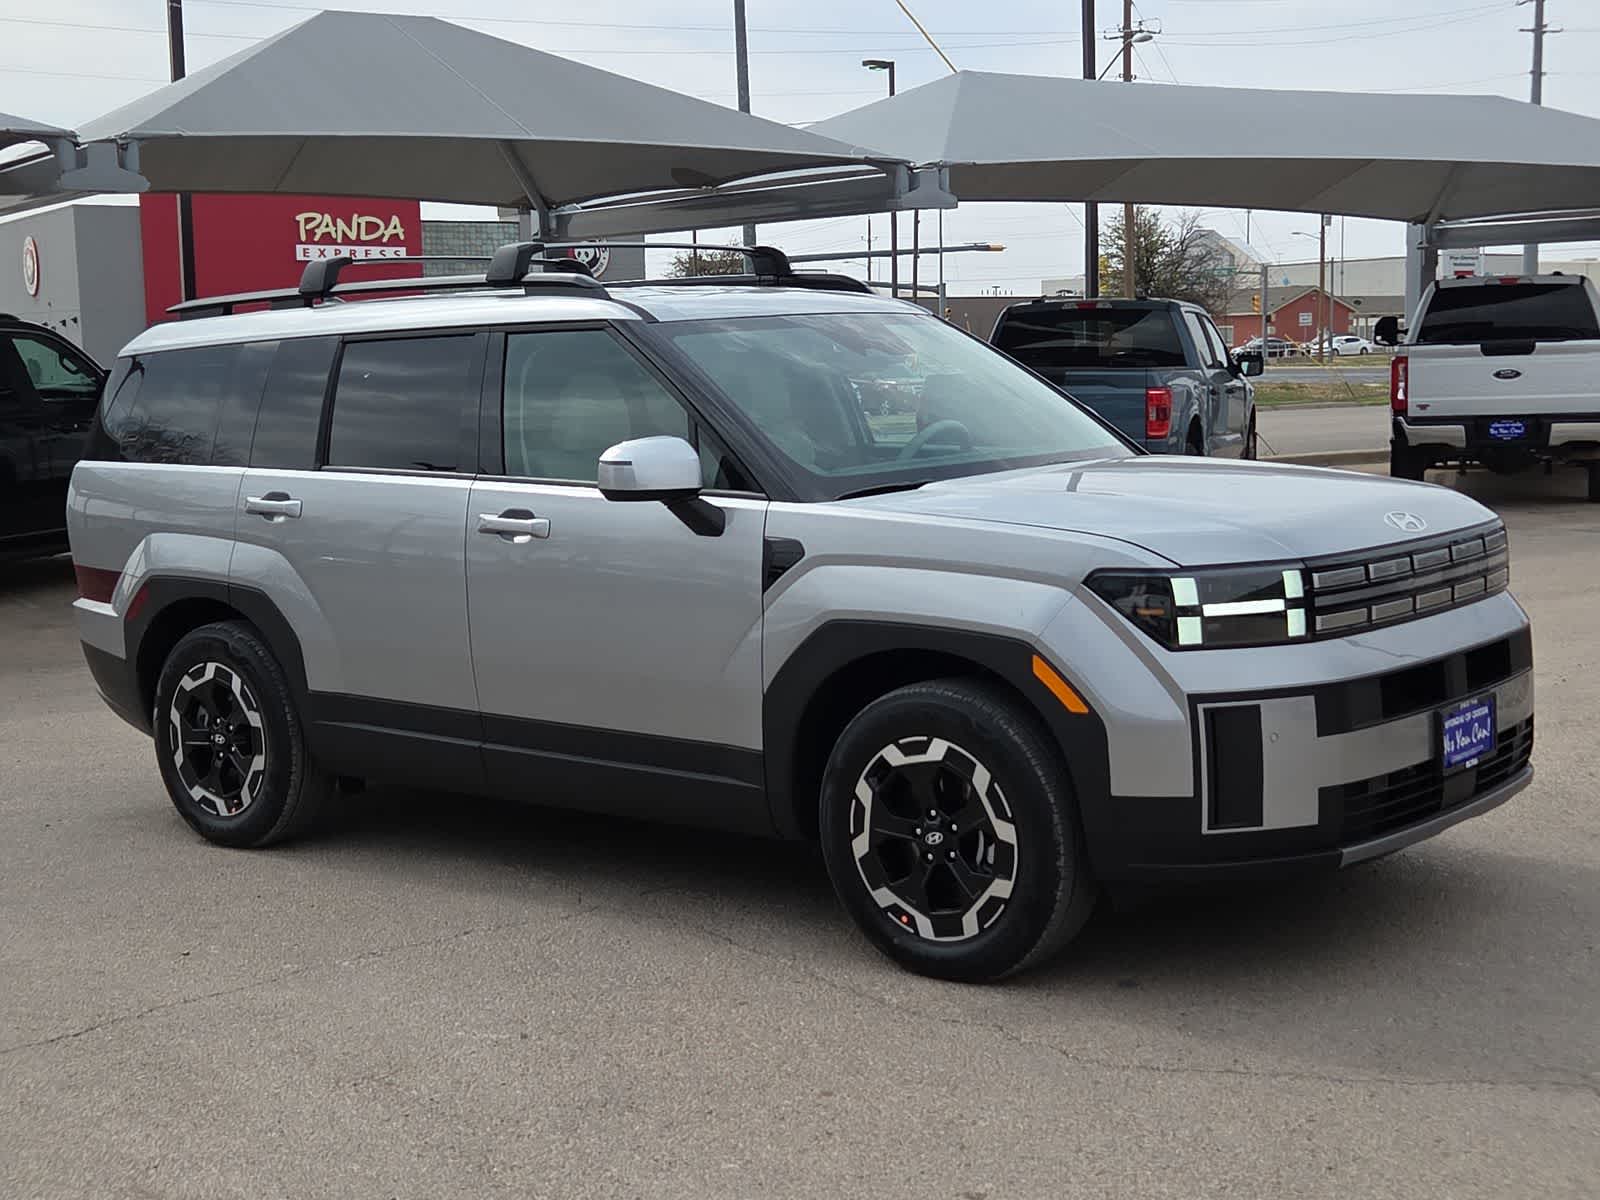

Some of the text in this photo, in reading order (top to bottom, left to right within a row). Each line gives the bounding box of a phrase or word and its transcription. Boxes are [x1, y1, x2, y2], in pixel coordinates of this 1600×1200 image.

[295, 212, 404, 243] PANDA
[302, 247, 401, 258] EXPRESS
[1455, 728, 1471, 750] You
